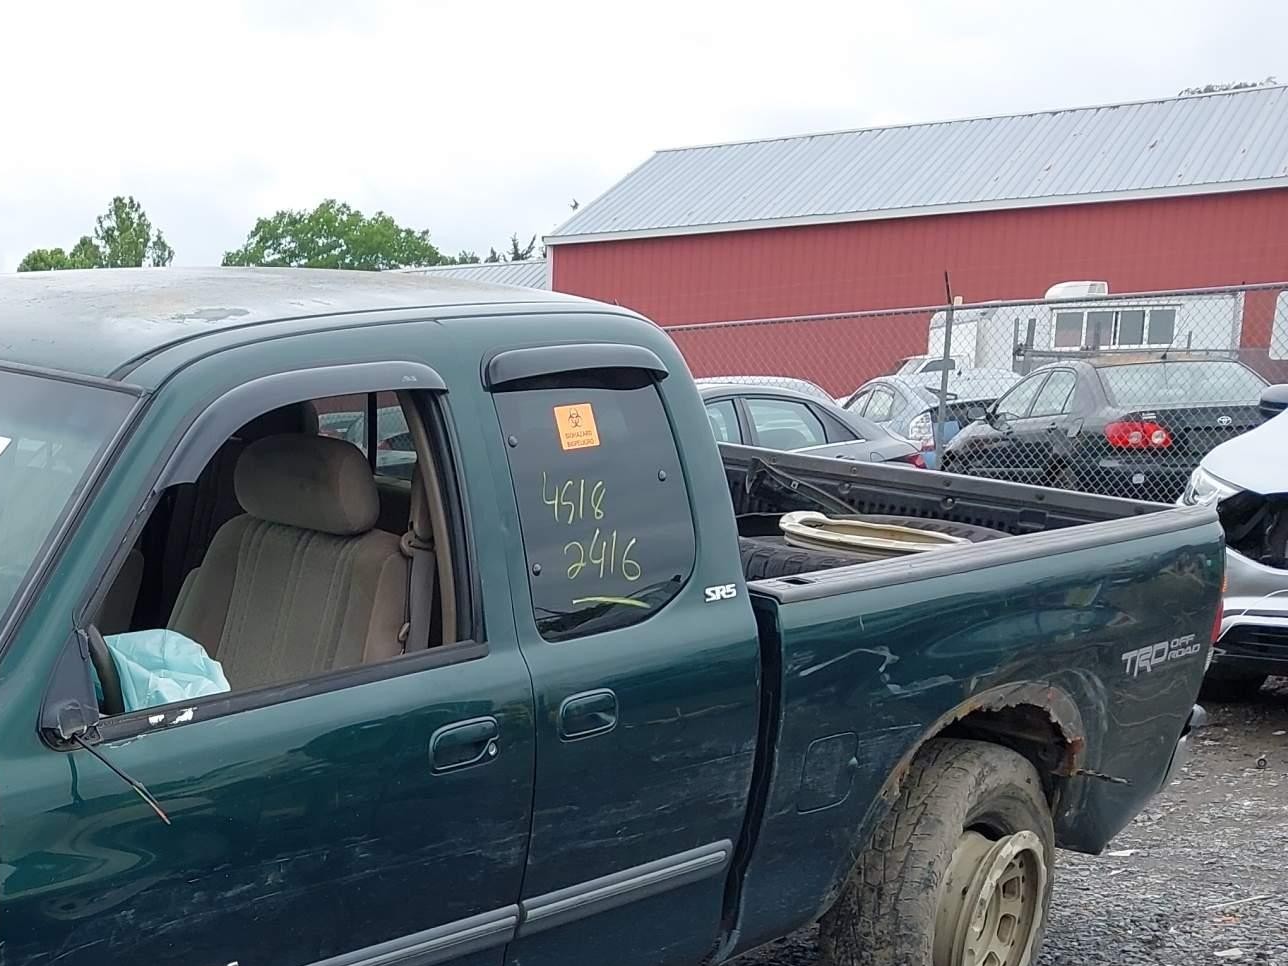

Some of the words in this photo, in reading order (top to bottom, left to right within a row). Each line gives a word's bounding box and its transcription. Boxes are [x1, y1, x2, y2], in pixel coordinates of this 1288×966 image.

[542, 471, 607, 525] 4518
[563, 527, 642, 582] 2416
[704, 583, 737, 602] SR5
[1121, 640, 1169, 678] TRD
[1170, 633, 1196, 649] OFF
[1167, 643, 1201, 661] ROAD
